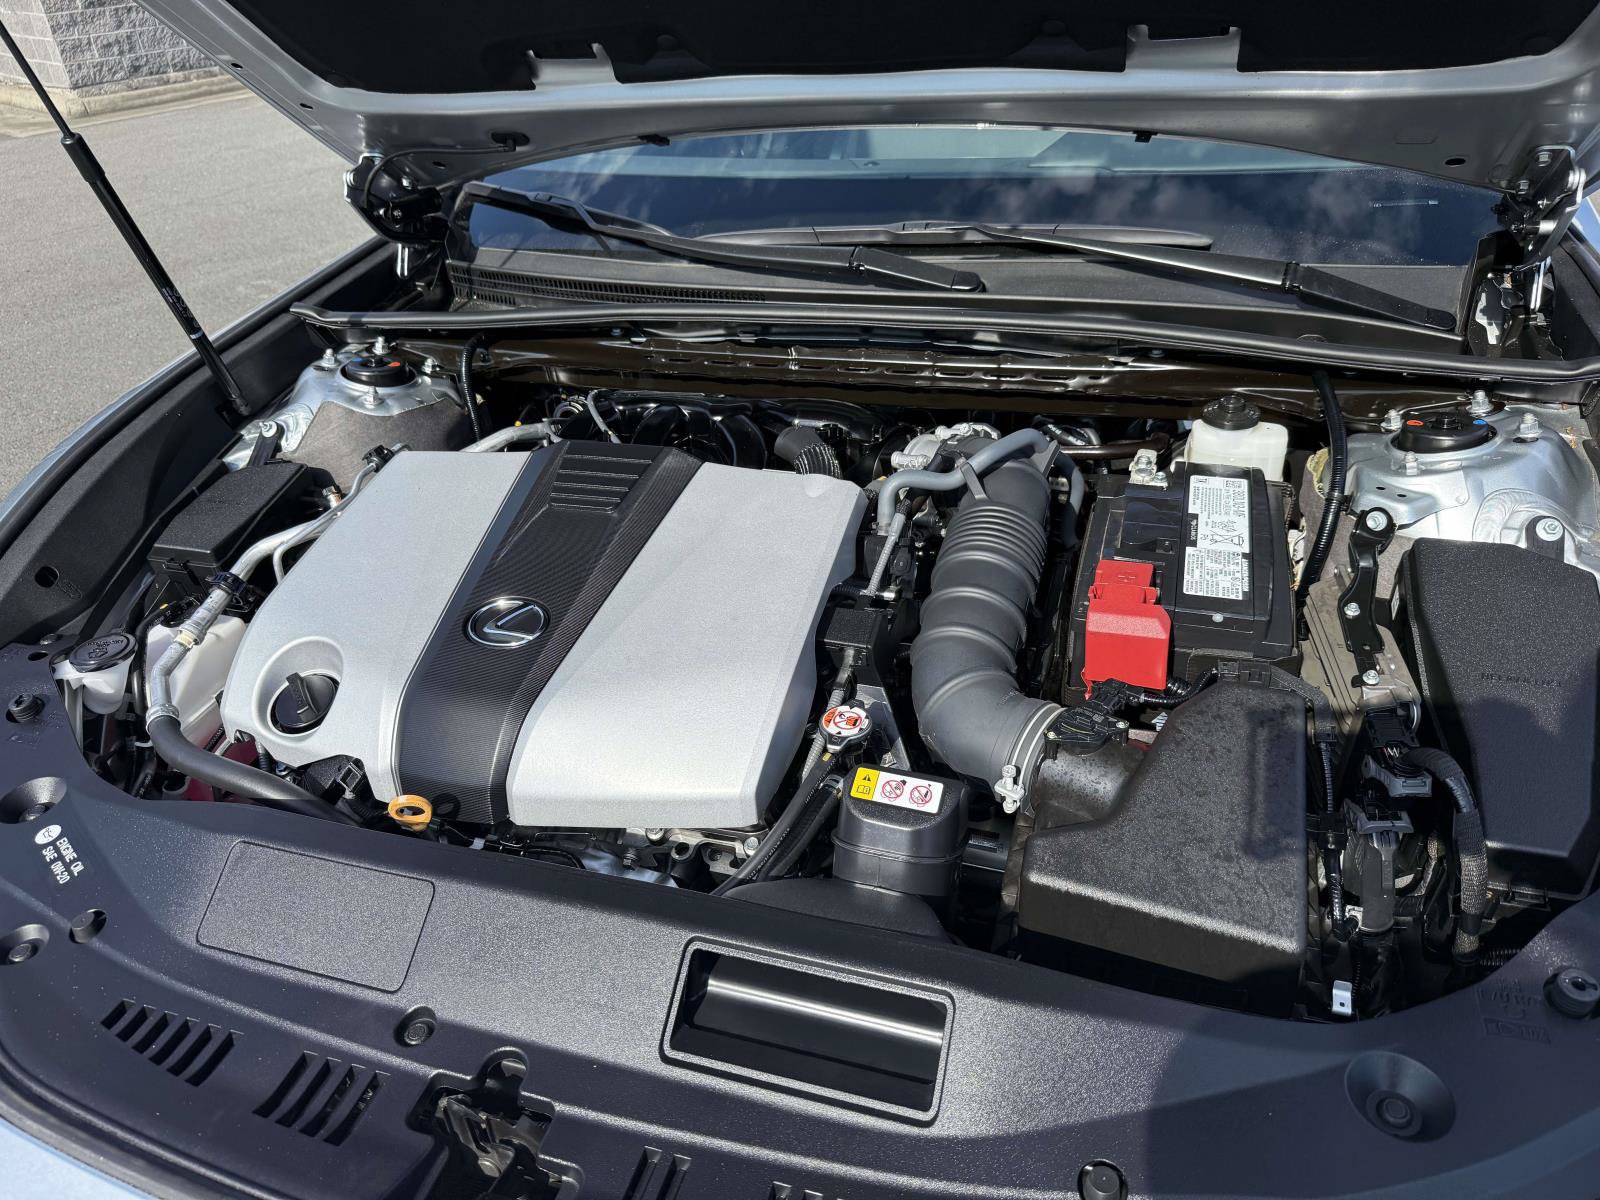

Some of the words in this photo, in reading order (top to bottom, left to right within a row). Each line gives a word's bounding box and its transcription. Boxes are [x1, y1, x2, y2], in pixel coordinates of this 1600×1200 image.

[42, 846, 58, 862] SAE
[50, 861, 71, 884] 0W-20
[56, 837, 78, 862] ENGINE
[70, 861, 85, 876] OIL
